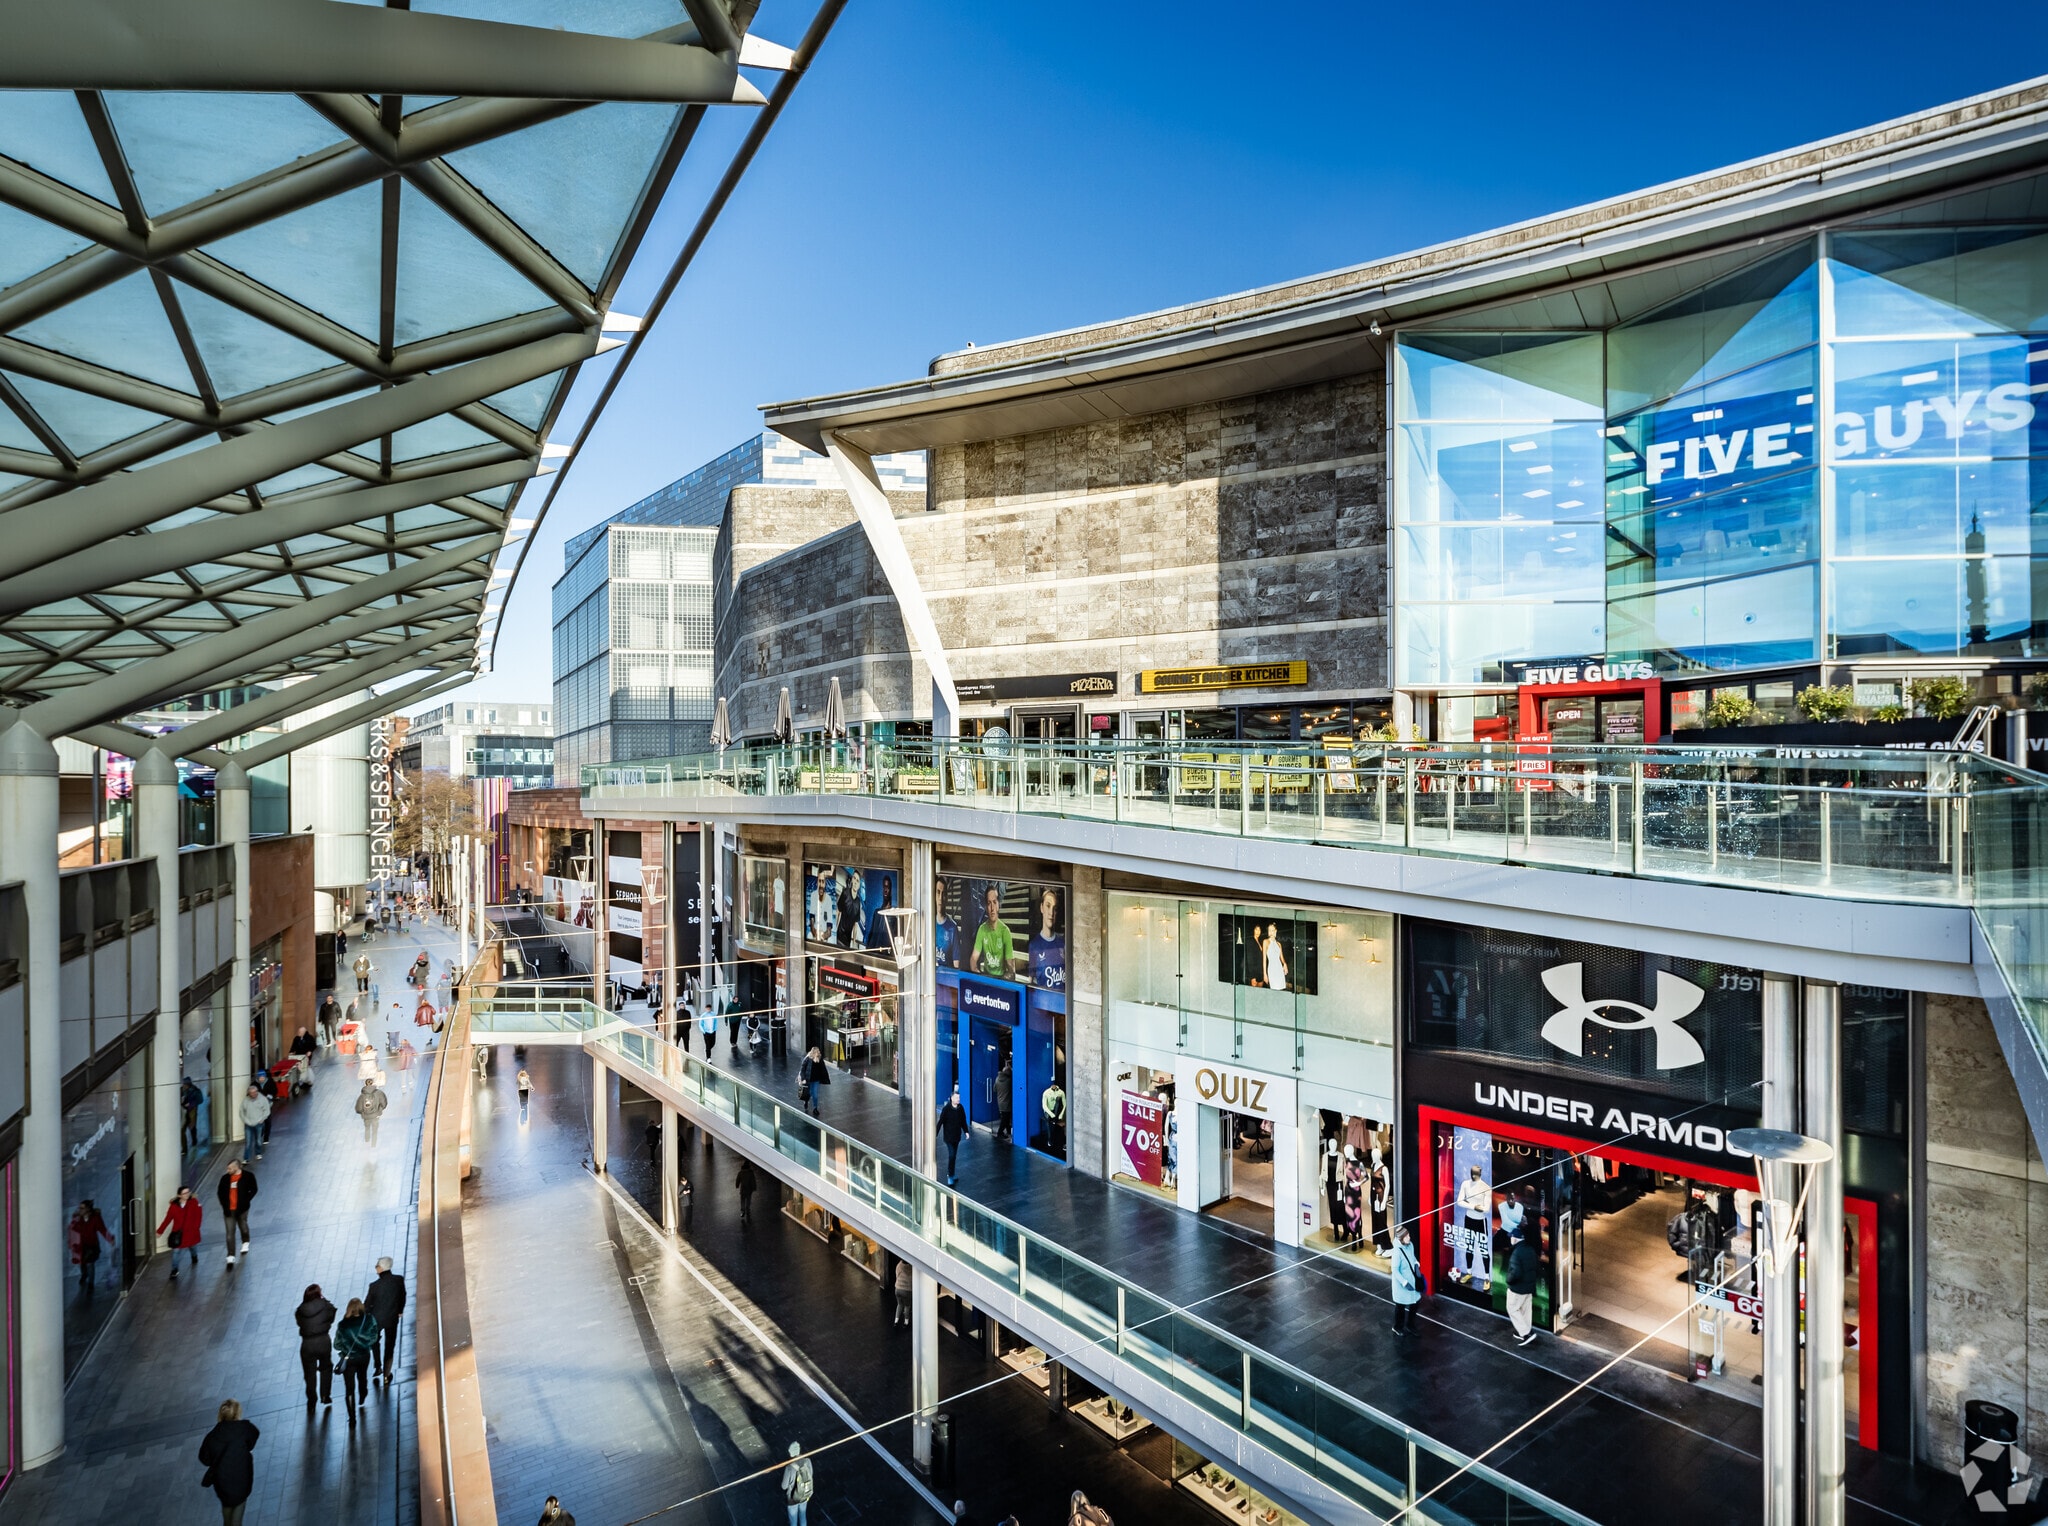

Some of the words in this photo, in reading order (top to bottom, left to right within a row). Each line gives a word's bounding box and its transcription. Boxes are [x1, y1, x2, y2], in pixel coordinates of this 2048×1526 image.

[1646, 422, 1792, 485] FIVE
[1834, 382, 2036, 458] GUYS
[1154, 673, 1200, 686] GOURMET
[1202, 670, 1242, 683] BURGER
[1246, 667, 1290, 680] KITCHEN
[1524, 667, 1578, 685] FIVE
[1584, 662, 1653, 682] GUYS
[1070, 677, 1113, 692] PIZZERIA
[1556, 710, 1581, 720] OPEN
[1775, 748, 1812, 759] FIVE
[371, 762, 389, 776] &
[371, 780, 391, 882] SPENCER
[615, 889, 642, 904] SEPHORA
[825, 975, 834, 984] THE
[834, 977, 854, 989] PERFUME
[855, 983, 868, 993] SHOP
[1045, 966, 1066, 988] Stake
[972, 993, 1011, 1012] evertontwo
[1117, 1072, 1132, 1082] QUIZ
[1195, 1068, 1268, 1113] QUIZ
[1128, 1103, 1156, 1122] SALE
[1475, 1082, 1594, 1126] UNDER
[1124, 1124, 1160, 1151] 70%
[1150, 1146, 1160, 1154] OFF
[1443, 1222, 1489, 1244] DEFEND
[1698, 1284, 1727, 1300] SALE
[1737, 1296, 1763, 1314] 60
